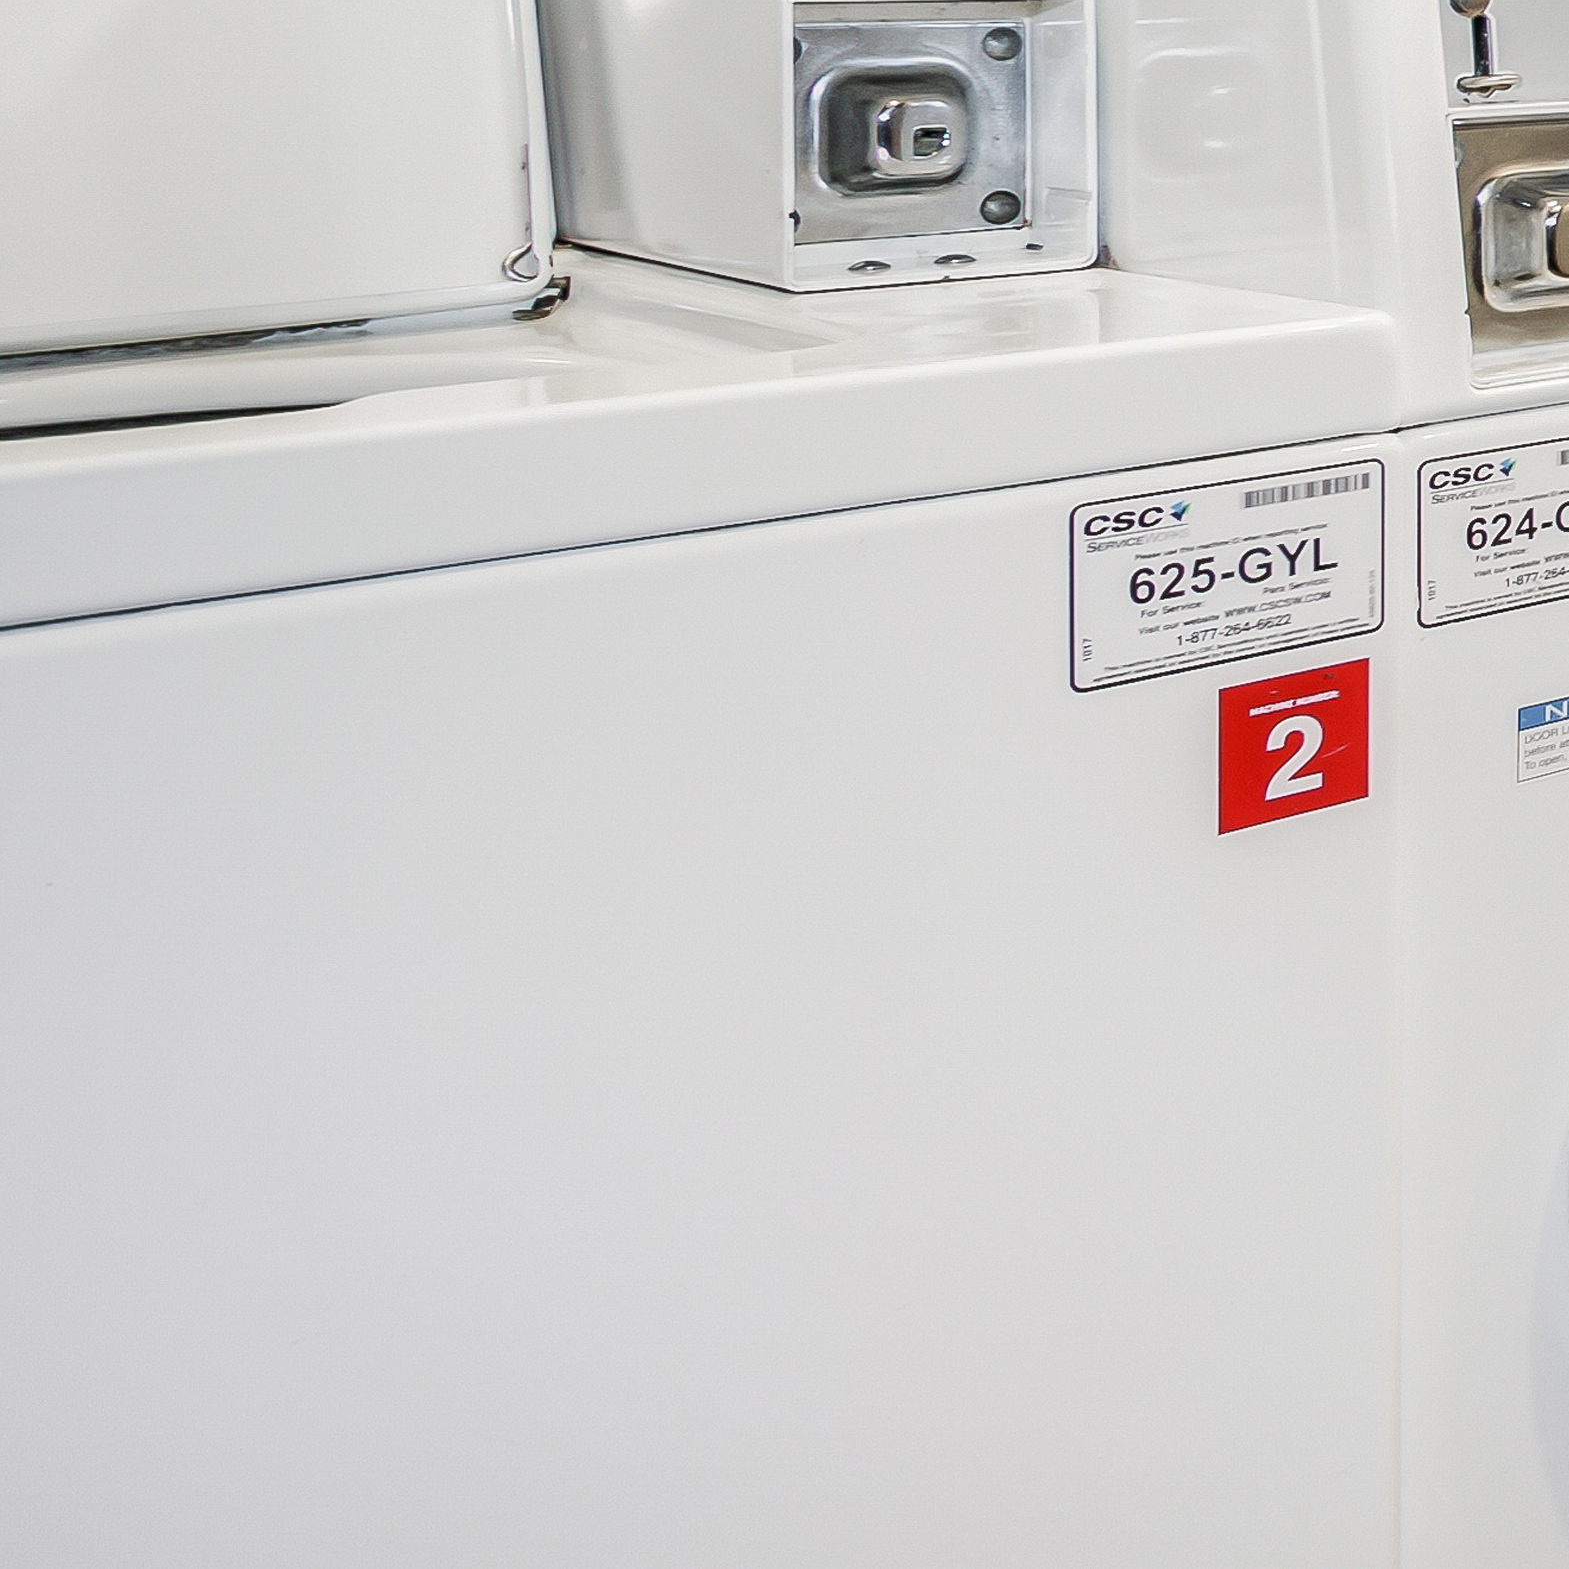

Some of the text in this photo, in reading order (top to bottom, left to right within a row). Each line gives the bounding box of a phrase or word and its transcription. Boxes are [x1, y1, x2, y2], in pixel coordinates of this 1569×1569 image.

[1429, 463, 1495, 489] CSC
[1083, 507, 1165, 536] CSC
[1475, 552, 1490, 563] For
[1129, 537, 1339, 604] 625-GYL
[1140, 609, 1160, 619] For
[1524, 728, 1559, 745] DOOR
[1264, 715, 1324, 802] 2
[1524, 742, 1556, 758] before
[1525, 760, 1537, 771] To
